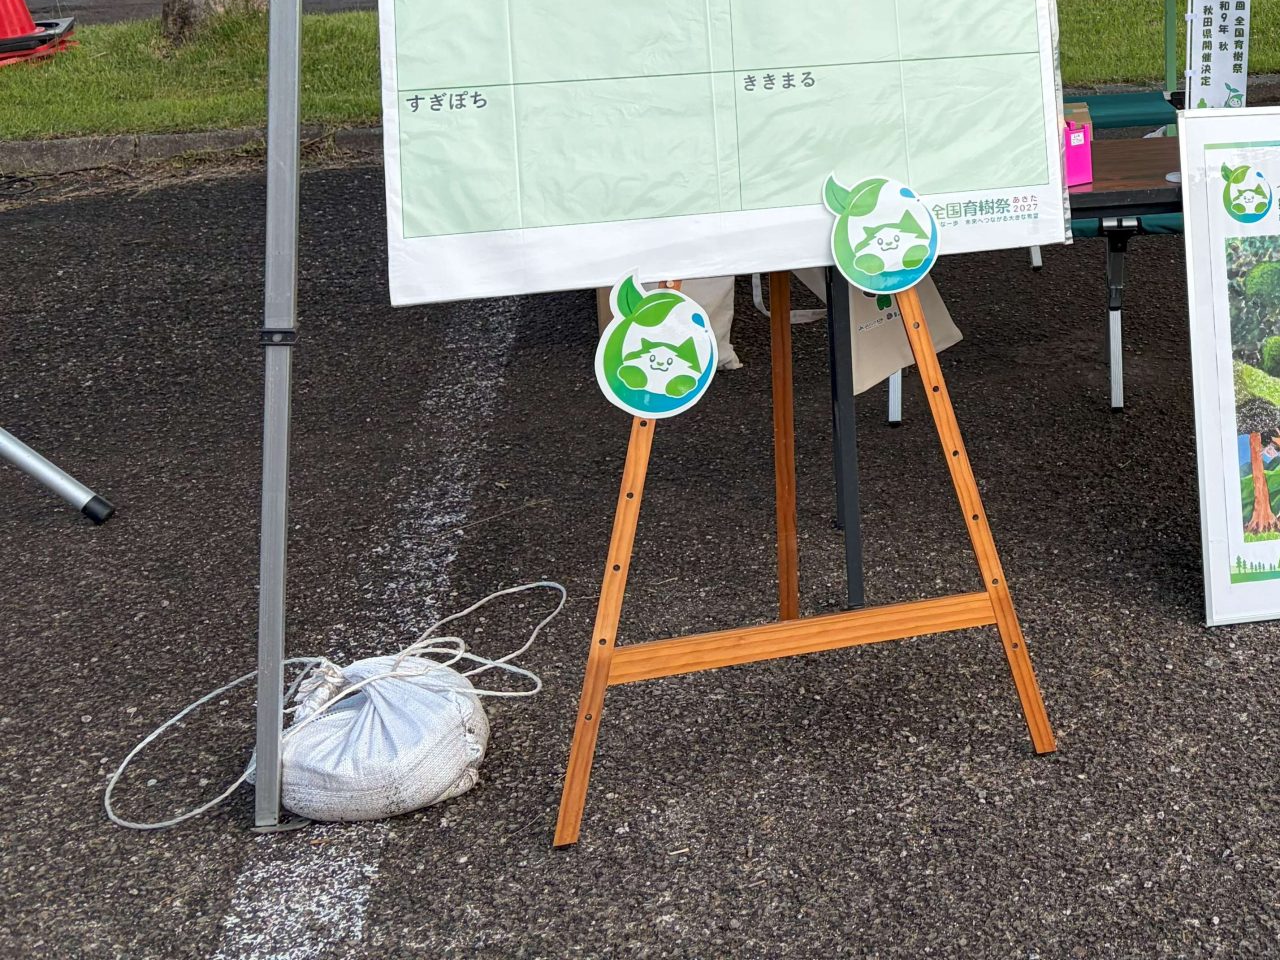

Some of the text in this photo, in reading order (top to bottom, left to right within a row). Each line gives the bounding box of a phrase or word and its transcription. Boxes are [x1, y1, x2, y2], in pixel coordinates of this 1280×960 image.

[1200, 5, 1214, 87] 秋田県開催決定
[1218, 41, 1229, 52] 秋
[1232, 16, 1246, 75] 全国育樹祭
[743, 70, 816, 90] ききまる
[406, 91, 488, 111] すぎぽち
[932, 198, 1011, 220] 全国育樹祭
[1013, 203, 1038, 213] 2027
